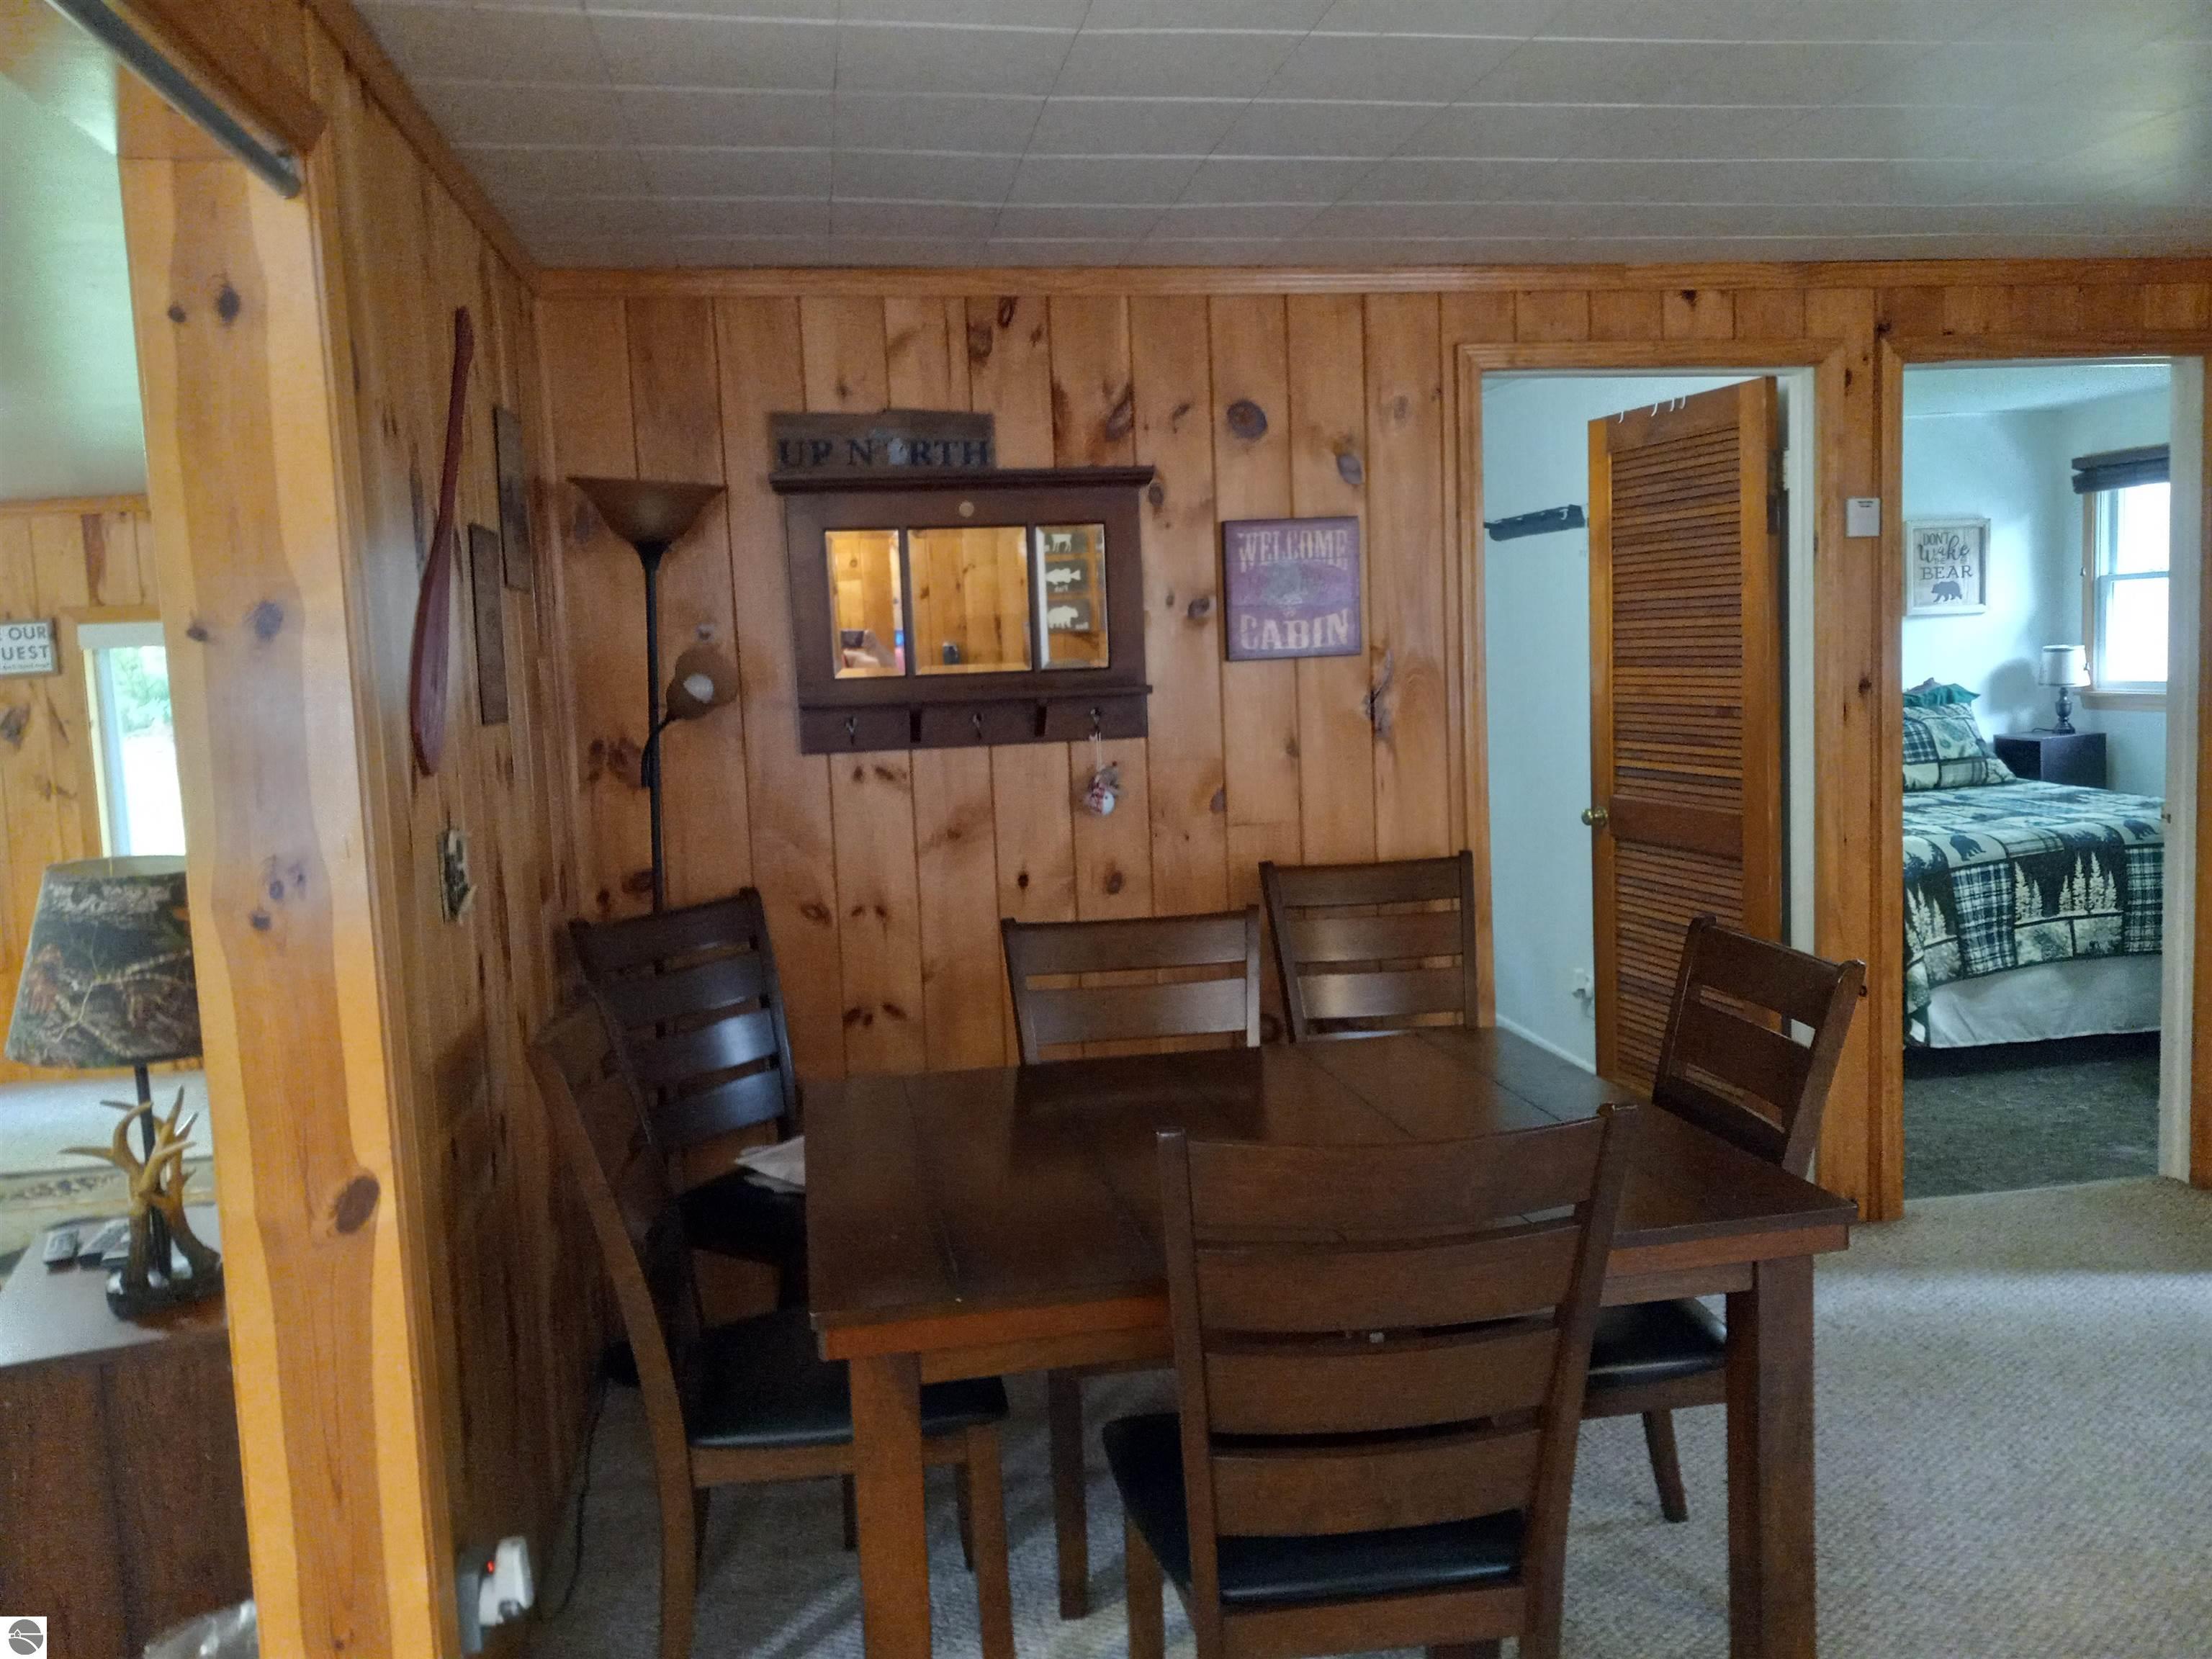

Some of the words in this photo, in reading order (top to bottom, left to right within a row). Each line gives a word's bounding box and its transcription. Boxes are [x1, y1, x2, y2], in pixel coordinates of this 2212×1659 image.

[776, 437, 832, 467] UP
[845, 433, 991, 467] NRTH
[1236, 529, 1348, 573] WELCOME
[1920, 565, 1973, 580] BEAR
[9, 626, 47, 641] OUR
[1240, 608, 1349, 650] CABIN
[0, 644, 49, 660] UEST
